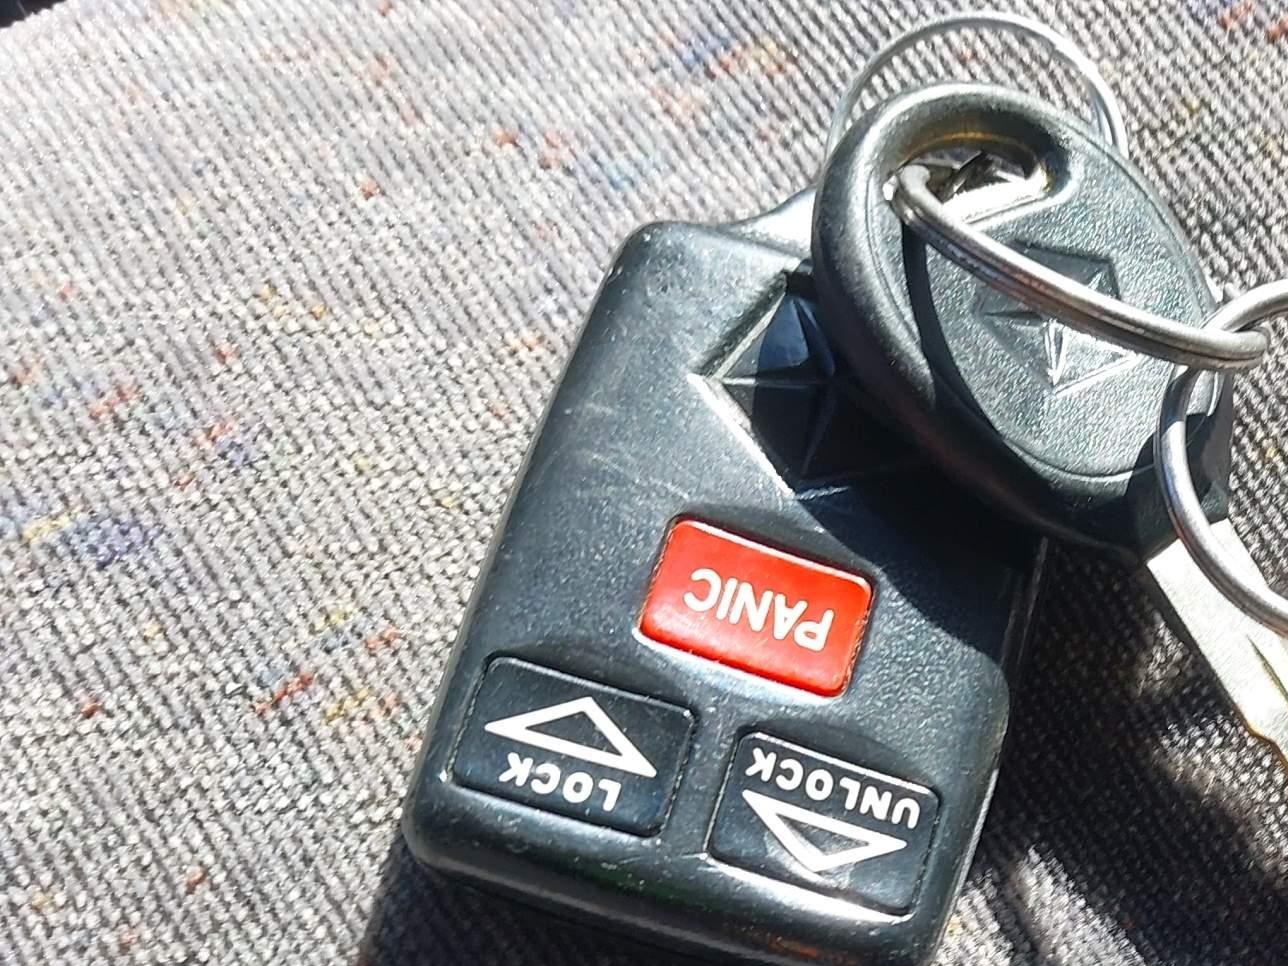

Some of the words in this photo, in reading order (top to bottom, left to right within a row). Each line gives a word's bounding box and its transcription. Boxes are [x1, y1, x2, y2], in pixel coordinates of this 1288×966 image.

[682, 567, 835, 652] PANIC
[499, 752, 622, 812] LOCK
[745, 747, 921, 829] UNLOCK
